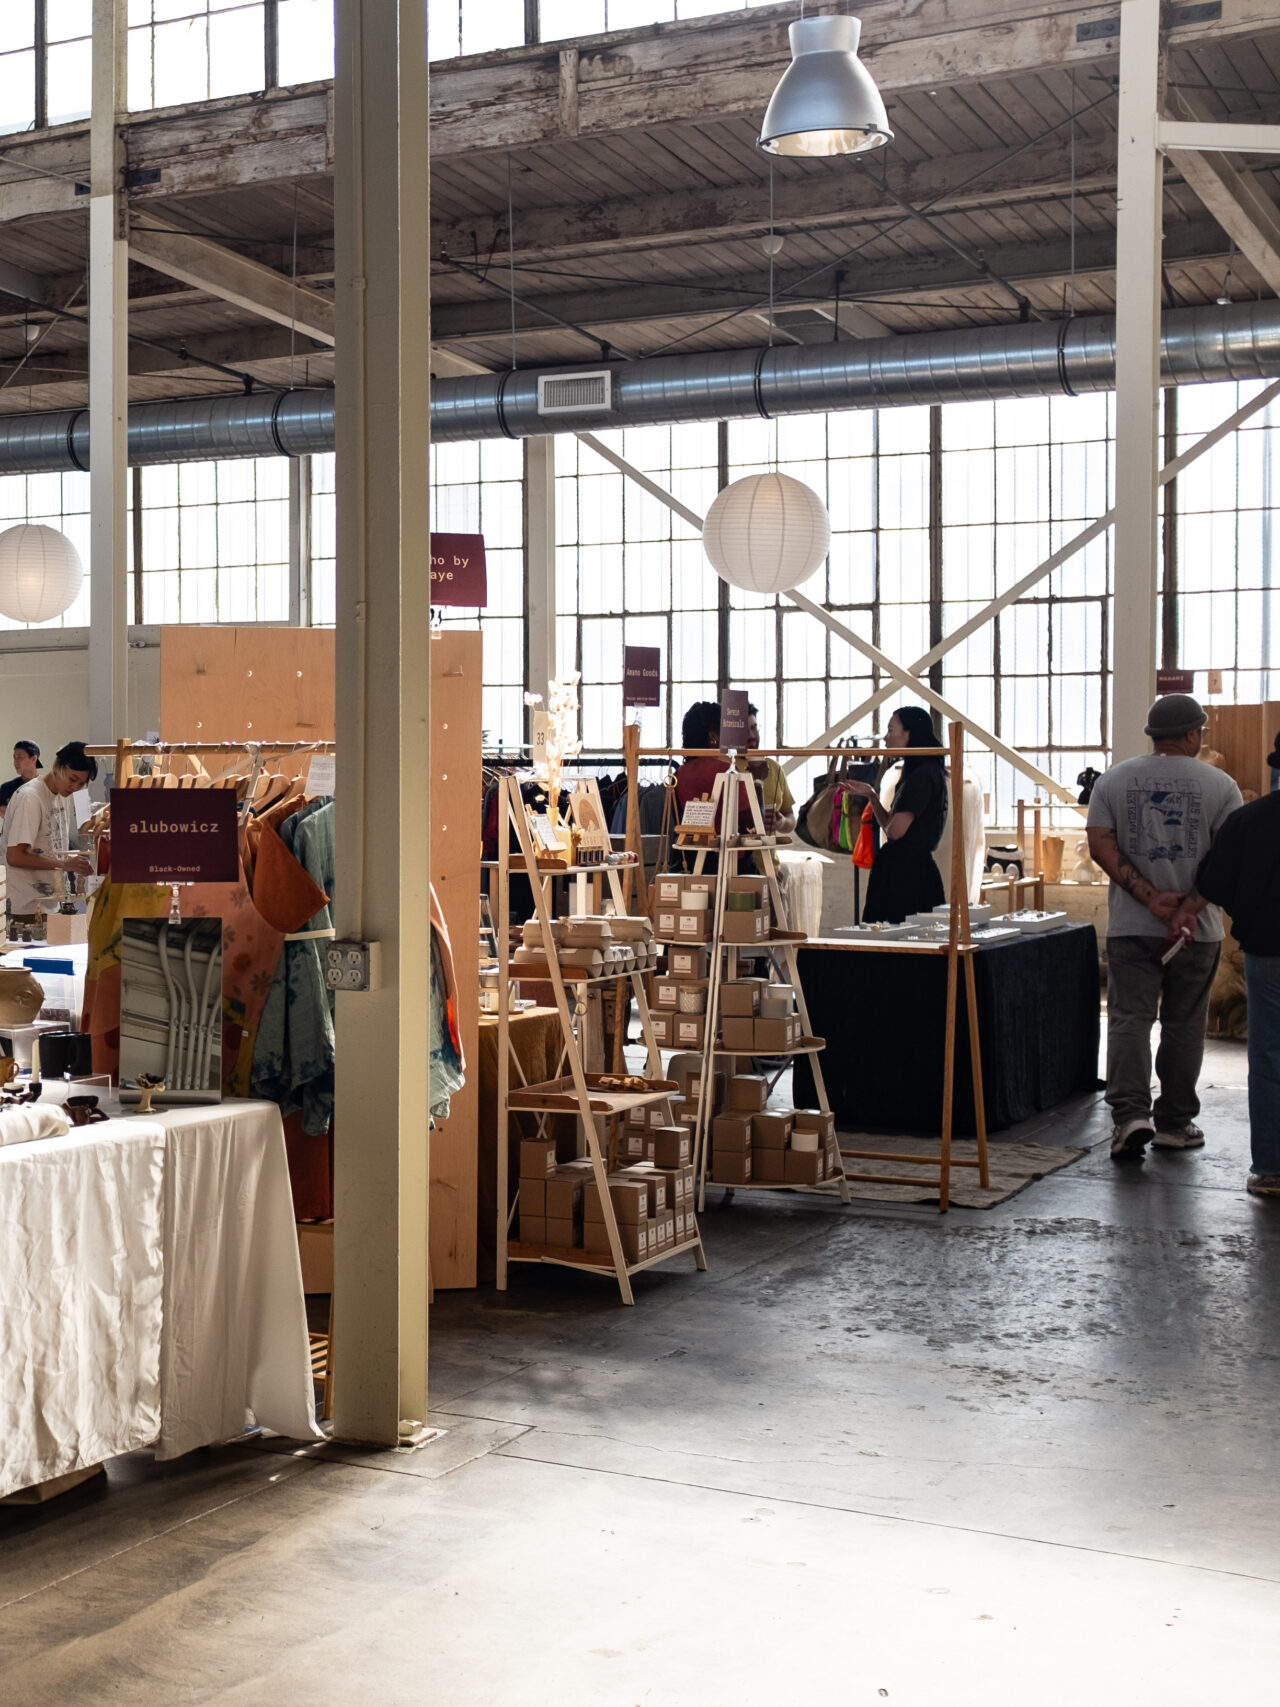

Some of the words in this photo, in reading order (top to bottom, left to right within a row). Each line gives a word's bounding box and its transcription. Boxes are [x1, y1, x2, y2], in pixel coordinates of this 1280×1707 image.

[453, 554, 469, 568] by
[536, 732, 545, 745] 33
[129, 820, 219, 833] alubowicz
[149, 865, 201, 873] Black-Owned
